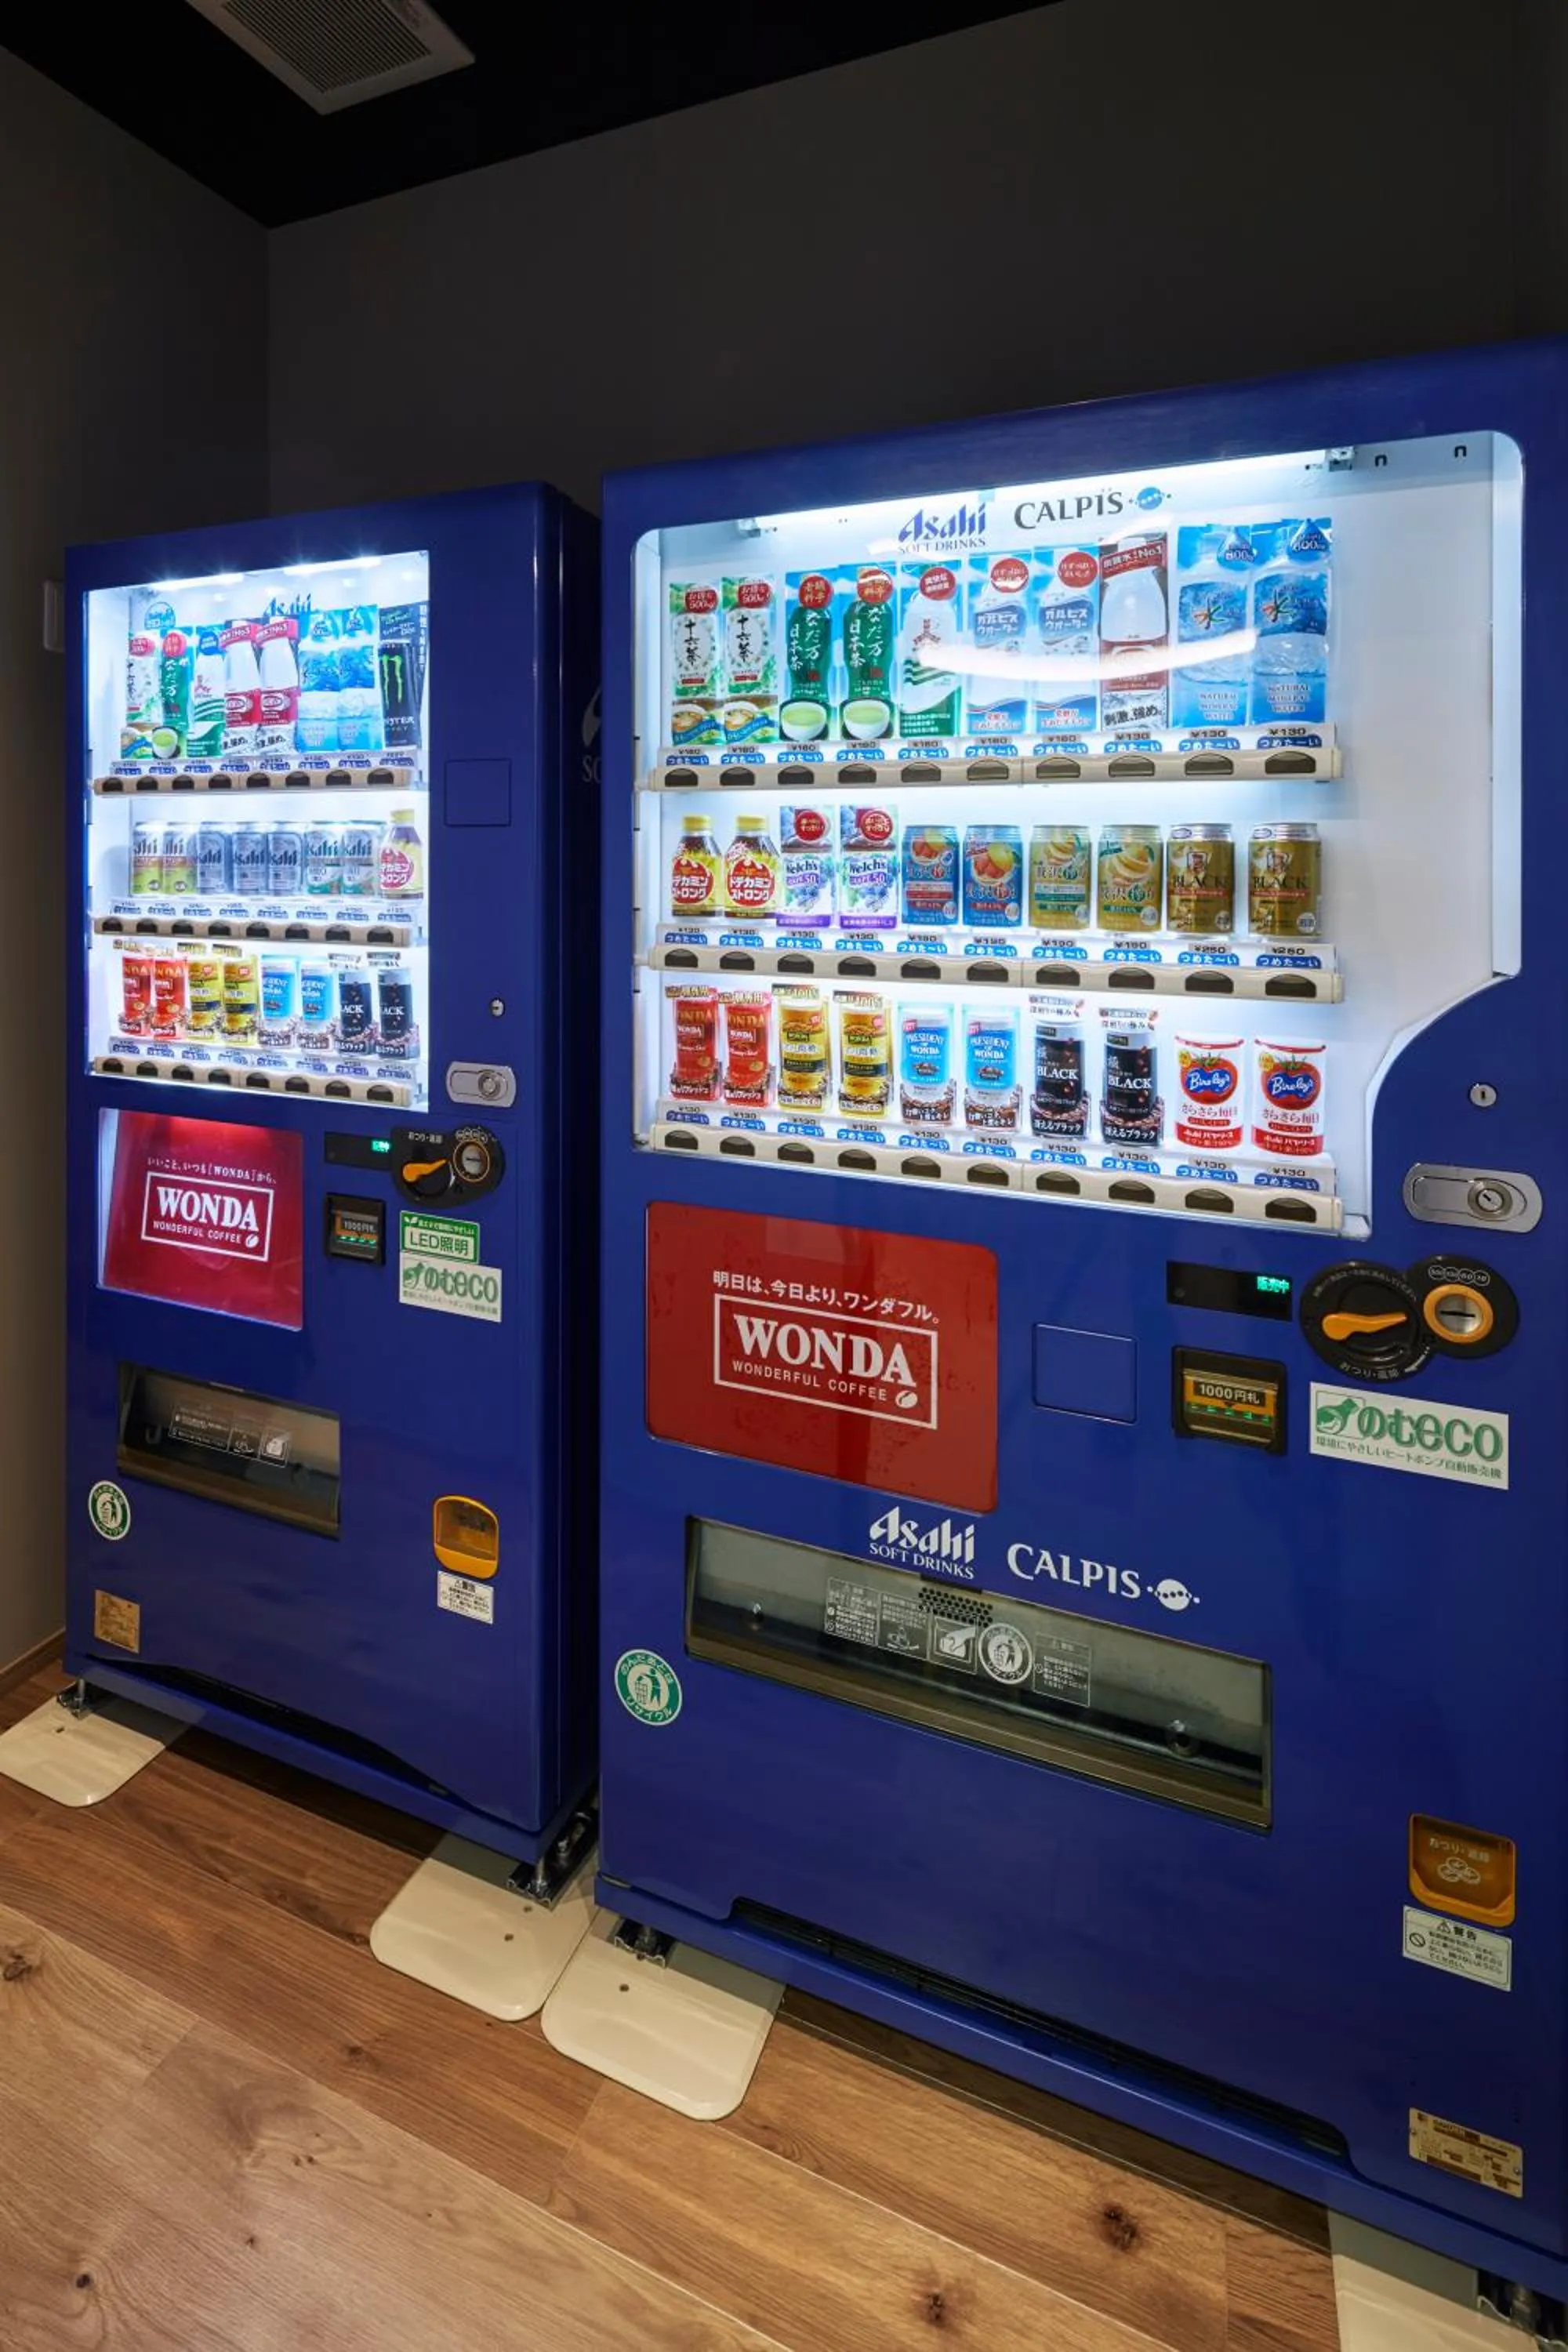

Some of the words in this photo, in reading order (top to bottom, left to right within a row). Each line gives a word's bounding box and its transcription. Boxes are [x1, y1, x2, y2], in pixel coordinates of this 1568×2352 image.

[898, 503, 985, 543] Asahi
[1014, 492, 1123, 530] CALPIS
[935, 538, 985, 552] DRINKS
[866, 607, 884, 656] なだ万
[1045, 608, 1088, 620] カルピス
[684, 619, 701, 666] 十六茶
[736, 615, 753, 662] 十六茶
[804, 611, 822, 660] なだ万
[850, 619, 866, 668] 日本茶
[728, 1013, 765, 1026] ONDA
[910, 1045, 939, 1055] WONDA
[975, 1050, 1004, 1059] WONDA
[1036, 1065, 1079, 1080] BLACK
[1108, 1076, 1153, 1089] BLACK
[157, 1186, 260, 1232] WONDA
[153, 1220, 204, 1238] WONDERFUL
[208, 1229, 241, 1245] COFFEE
[410, 1232, 468, 1256] LED照明
[713, 1270, 940, 1324] 明日は、今日より、ワンダフル。
[733, 1313, 917, 1388] WONDA
[731, 1359, 822, 1388] WONDERFUL
[828, 1379, 888, 1402] COFFEE
[1200, 1383, 1261, 1405] 1000円札
[1357, 1406, 1504, 1462] のむeco
[1316, 1435, 1503, 1480] 環境にやさしいヒートポンプ自動販売機
[869, 1505, 975, 1564] Asahi
[869, 1542, 908, 1564] SOFT
[913, 1552, 975, 1581] DRINKS
[1007, 1543, 1141, 1599] CALPIS
